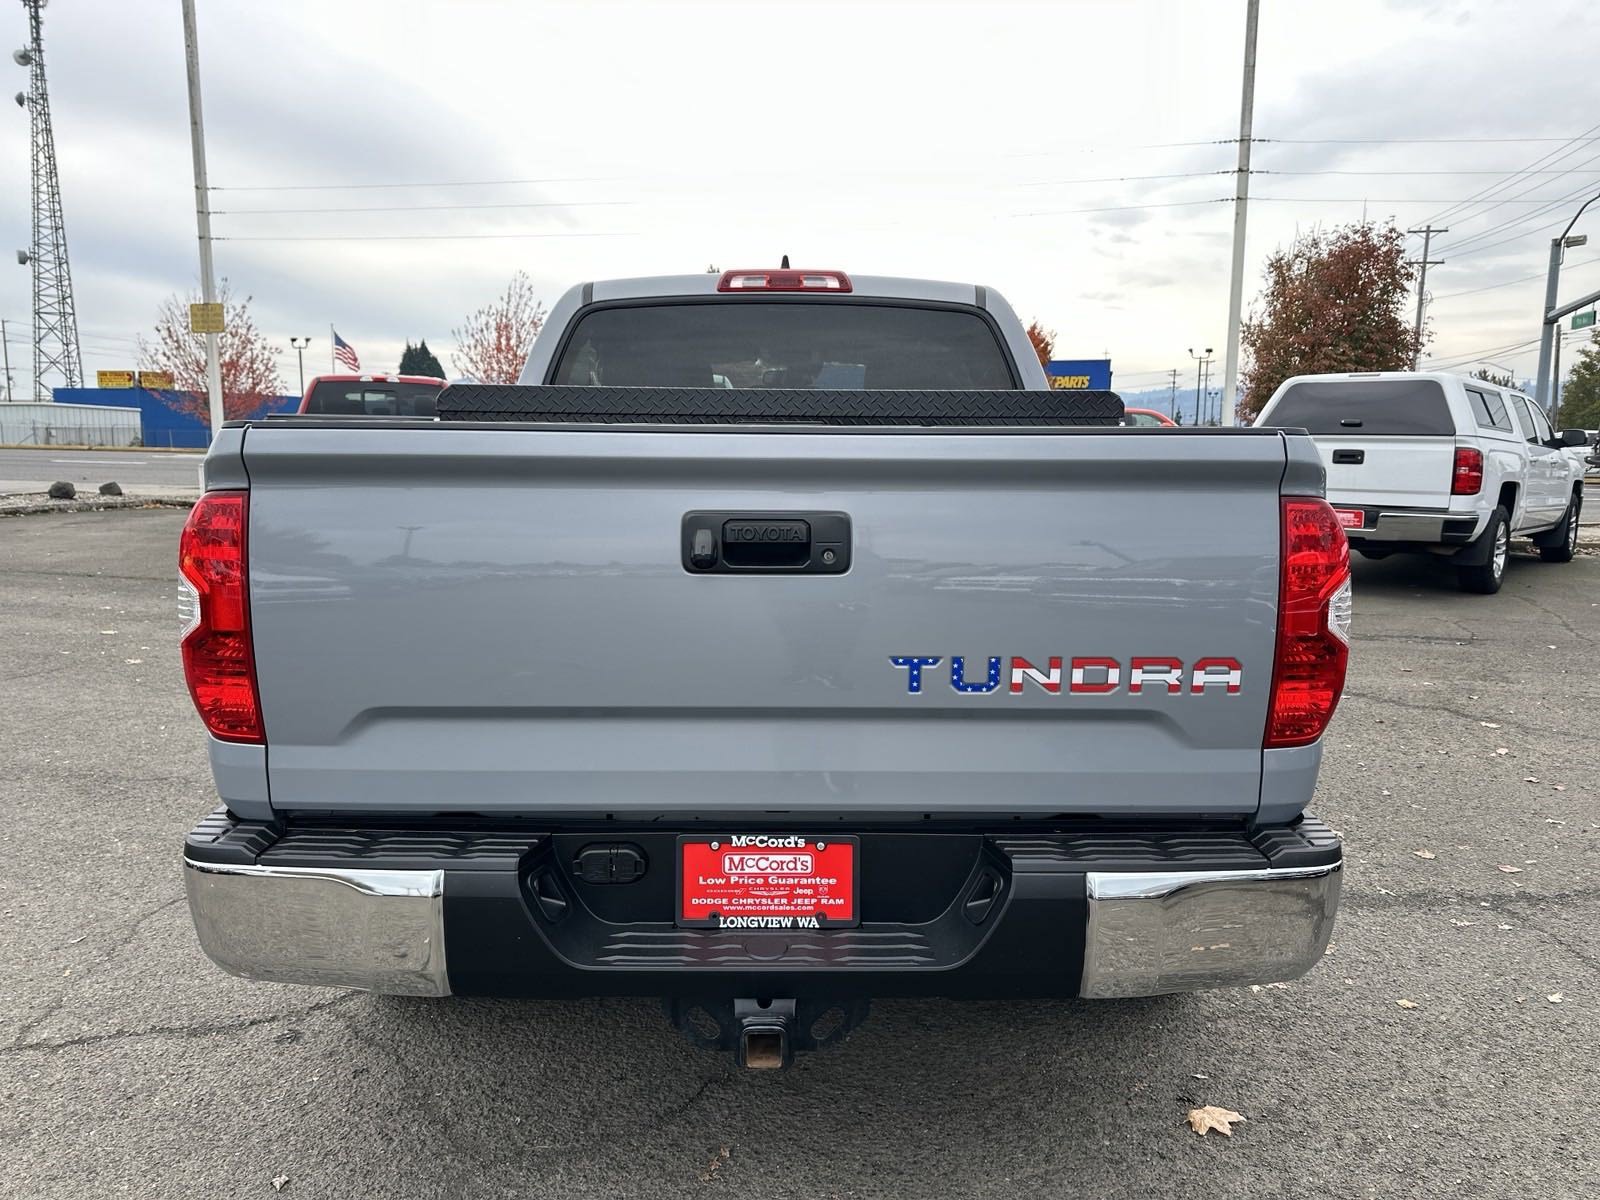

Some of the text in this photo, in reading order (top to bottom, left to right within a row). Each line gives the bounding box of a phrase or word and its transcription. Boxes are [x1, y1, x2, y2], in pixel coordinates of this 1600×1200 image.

[1055, 376, 1090, 388] PARTS
[731, 526, 804, 541] TOYOTA
[889, 655, 1243, 696] TUNDRA
[731, 835, 806, 848] McCord's
[727, 856, 809, 872] McCord's
[699, 876, 837, 885] Low Price Guarantee
[793, 887, 814, 896] Jeep
[719, 916, 820, 929] LONGVIEW WA
